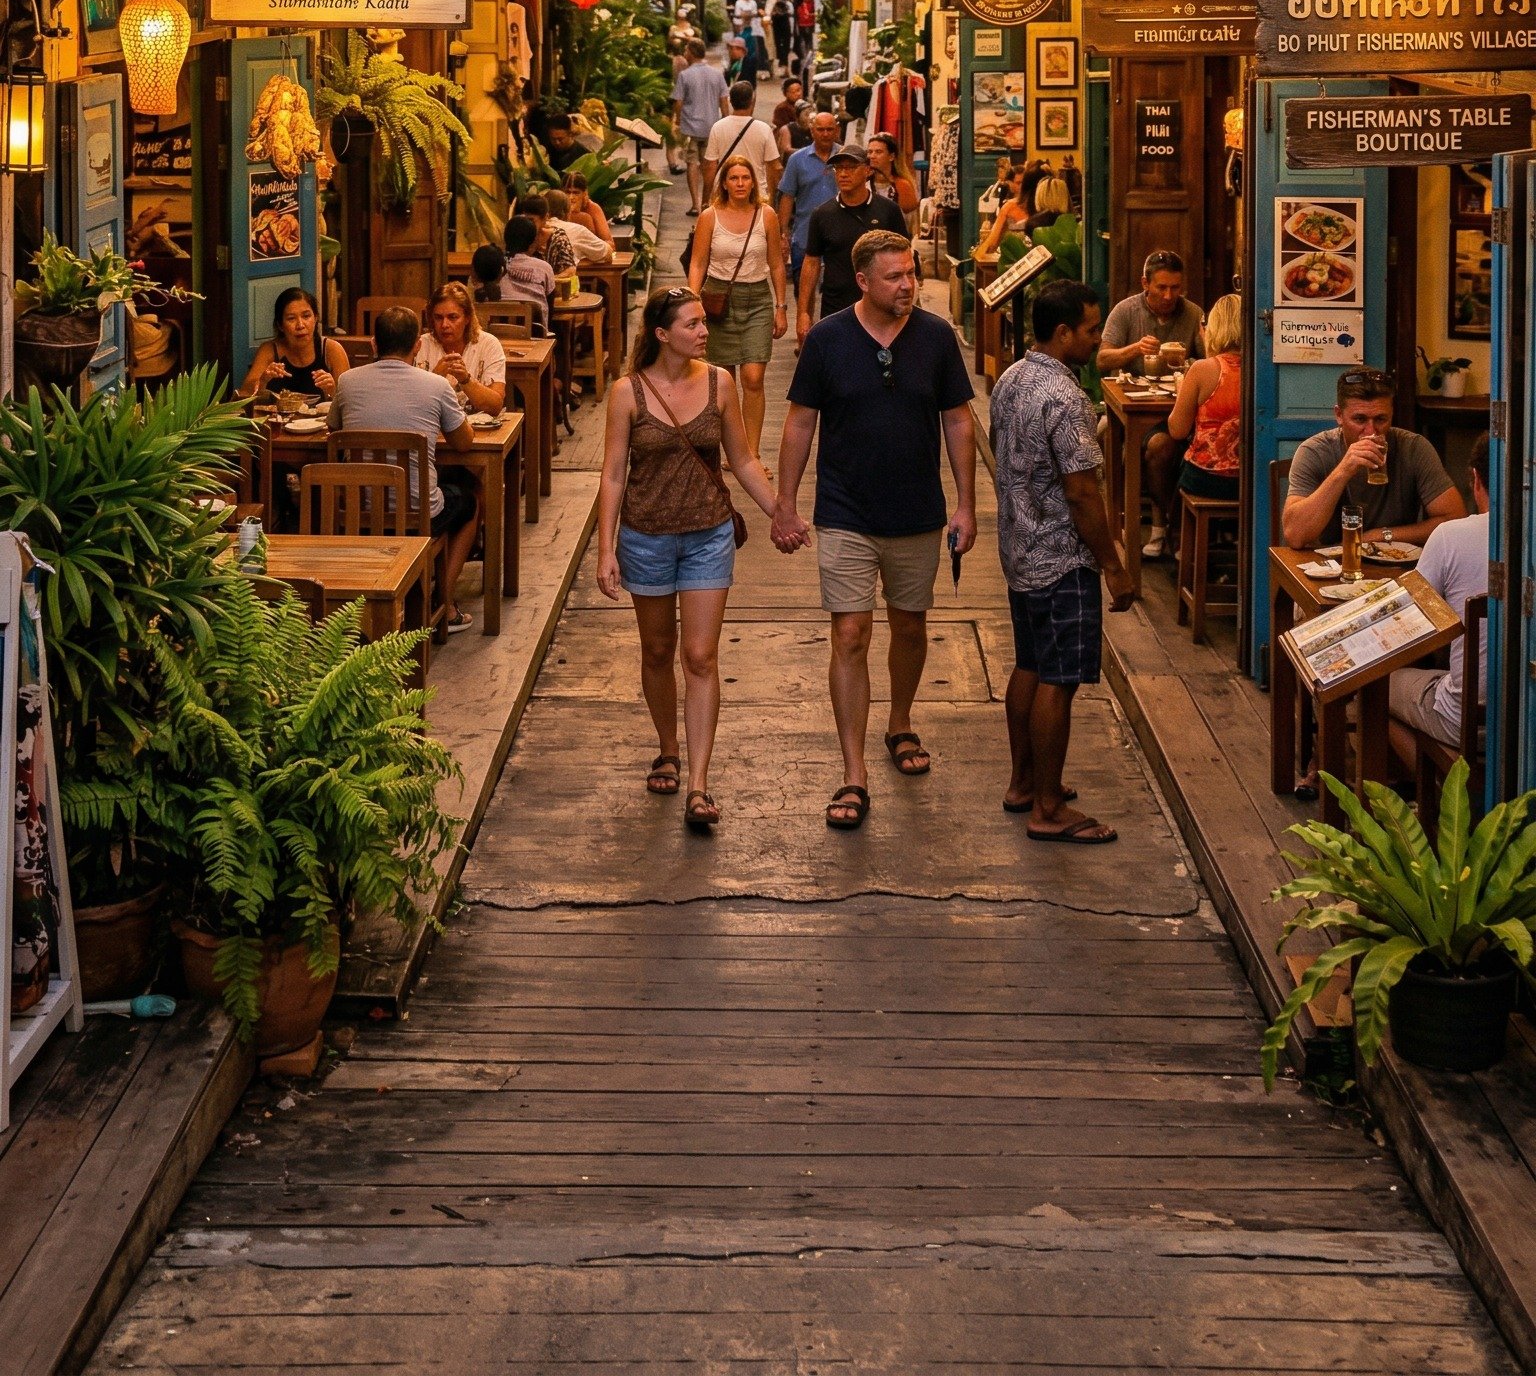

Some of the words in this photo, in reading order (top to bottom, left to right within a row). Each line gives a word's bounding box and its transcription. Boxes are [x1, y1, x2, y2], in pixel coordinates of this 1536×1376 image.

[1278, 34, 1300, 53] BO
[1307, 33, 1351, 52] PHUT
[1357, 31, 1464, 52] FISHERMAN'S
[1470, 29, 1536, 50] VILLAGE
[1145, 106, 1171, 116] THAI
[1306, 108, 1442, 129] FISHERMAN'S
[1449, 107, 1512, 126] TABLE
[1141, 145, 1175, 155] FOOD
[1356, 132, 1463, 152] BOUTIQUE
